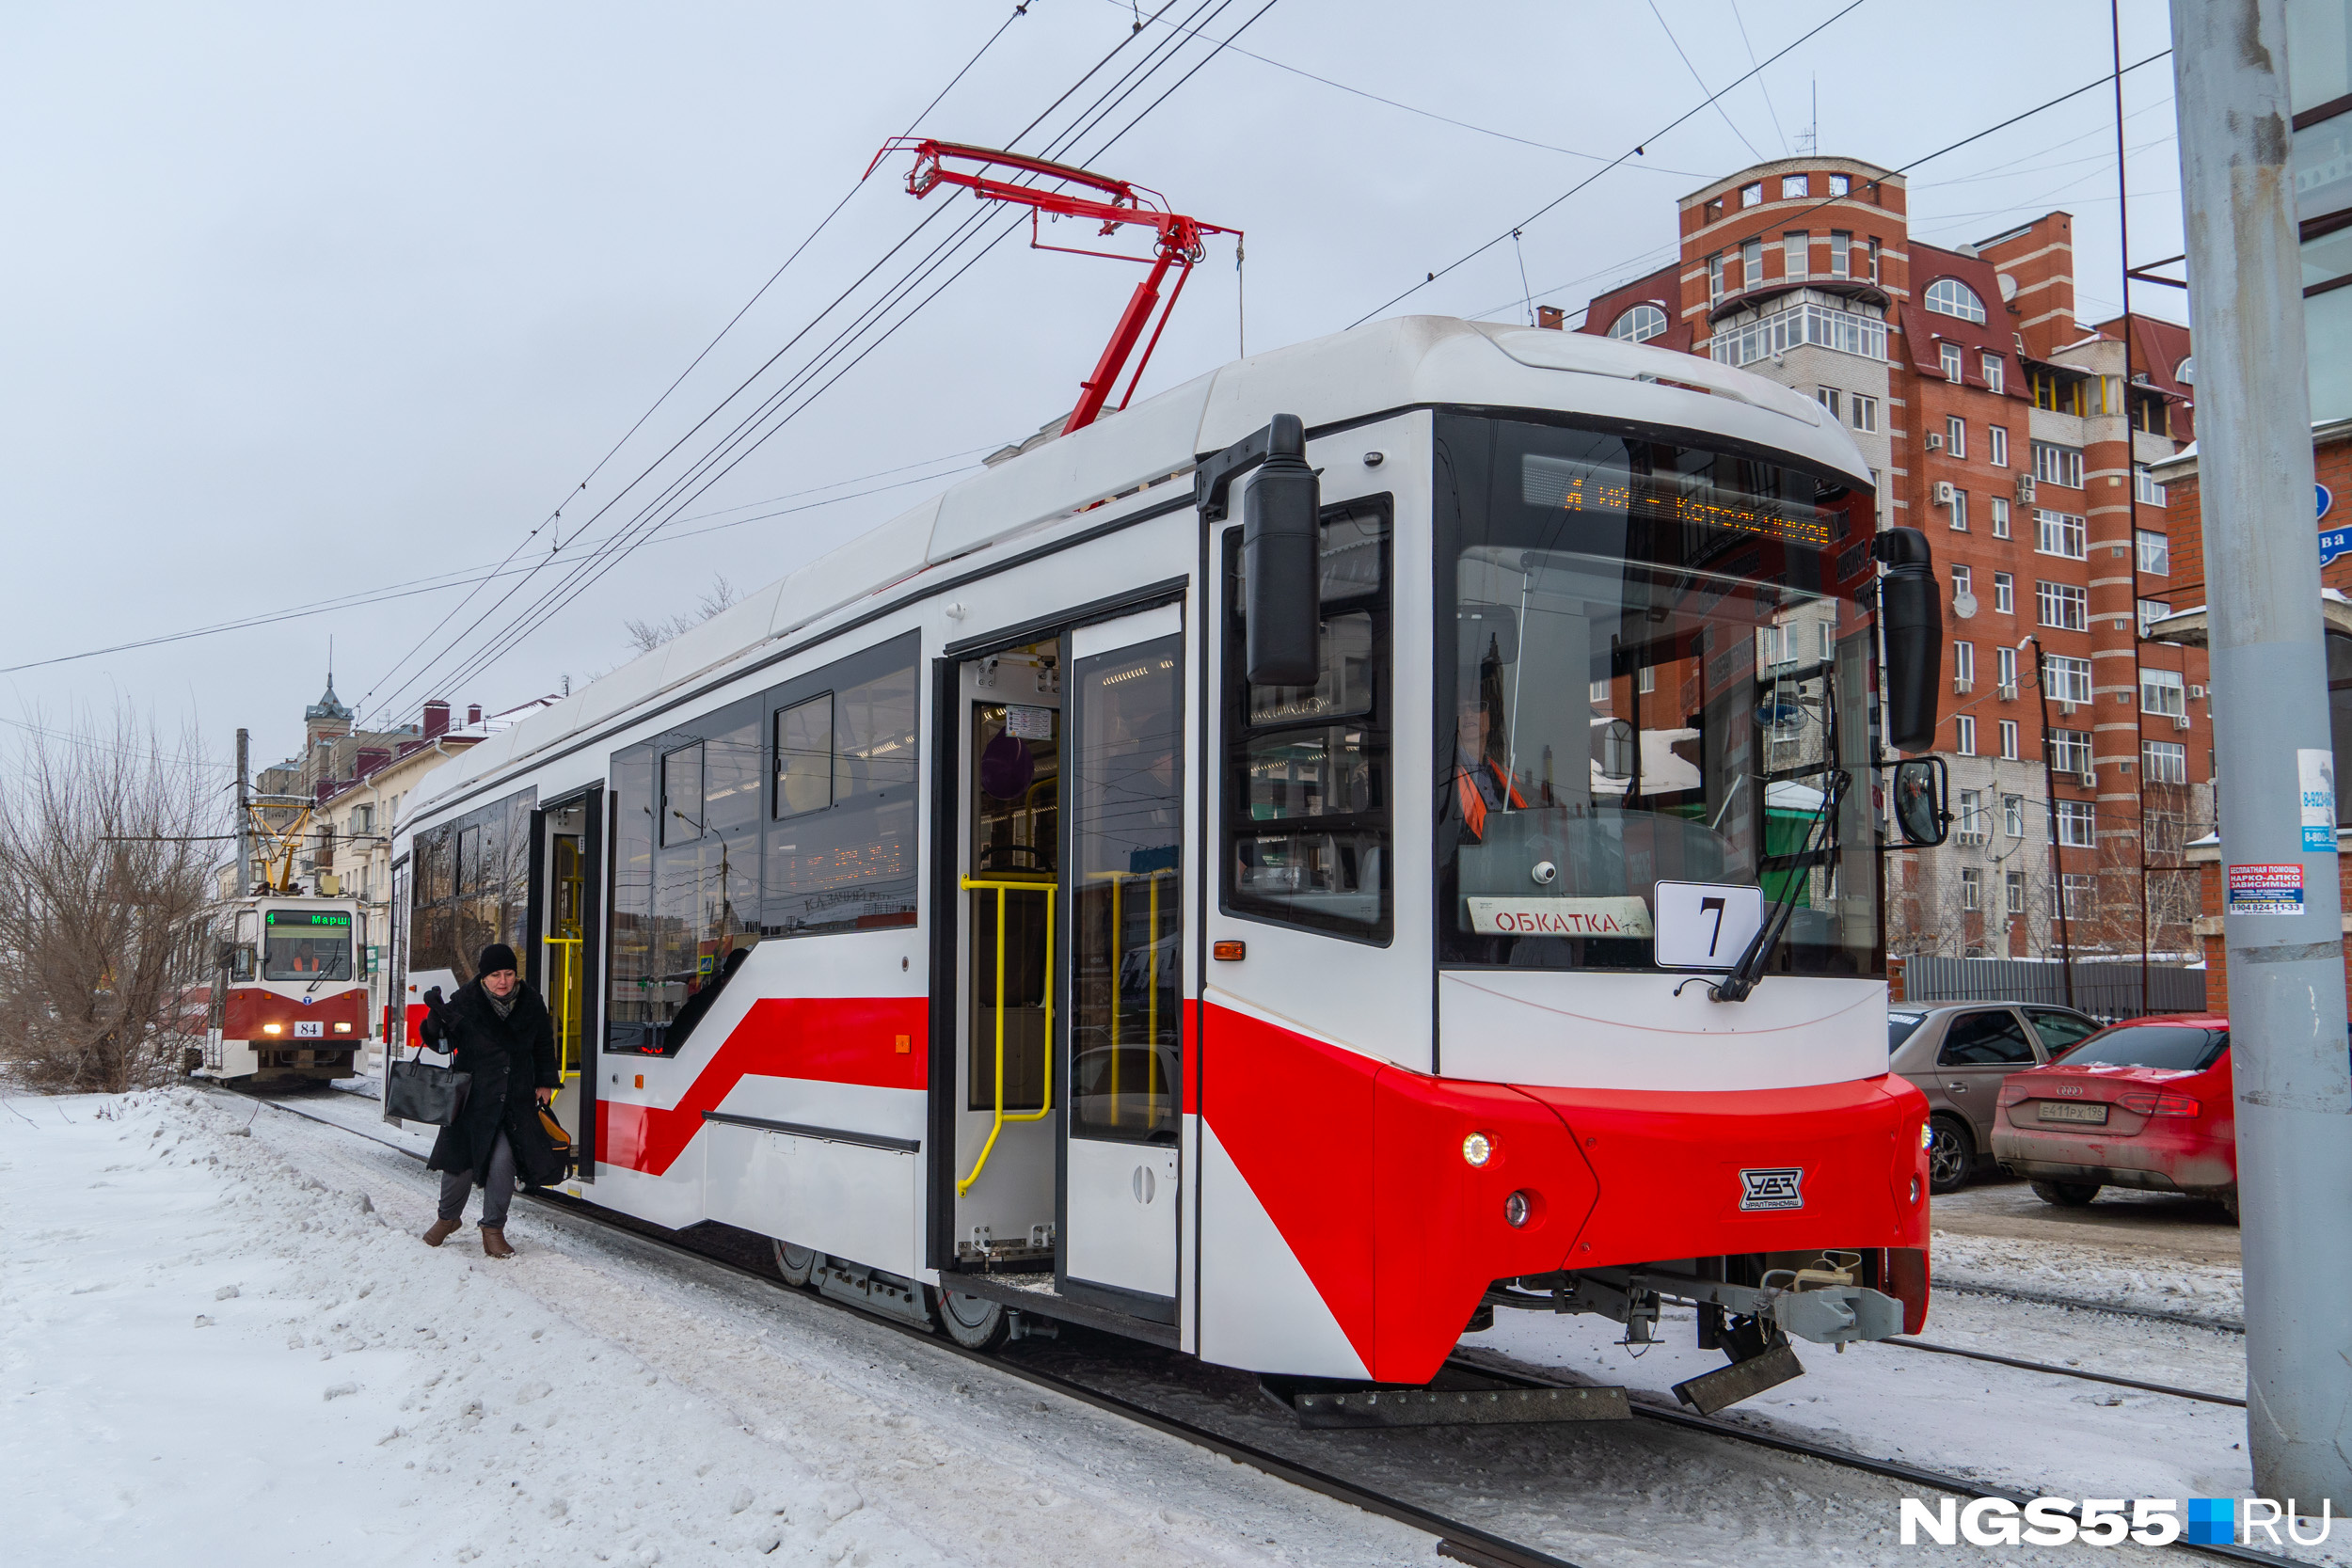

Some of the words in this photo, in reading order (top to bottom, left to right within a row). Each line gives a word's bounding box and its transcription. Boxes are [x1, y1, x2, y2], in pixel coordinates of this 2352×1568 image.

[266, 912, 276, 926] 4
[311, 915, 351, 926] Марш
[1495, 912, 1620, 933] ОБКАТКА
[1700, 896, 1726, 958] 7
[300, 1022, 318, 1036] 84
[2087, 1106, 2104, 1117] 196
